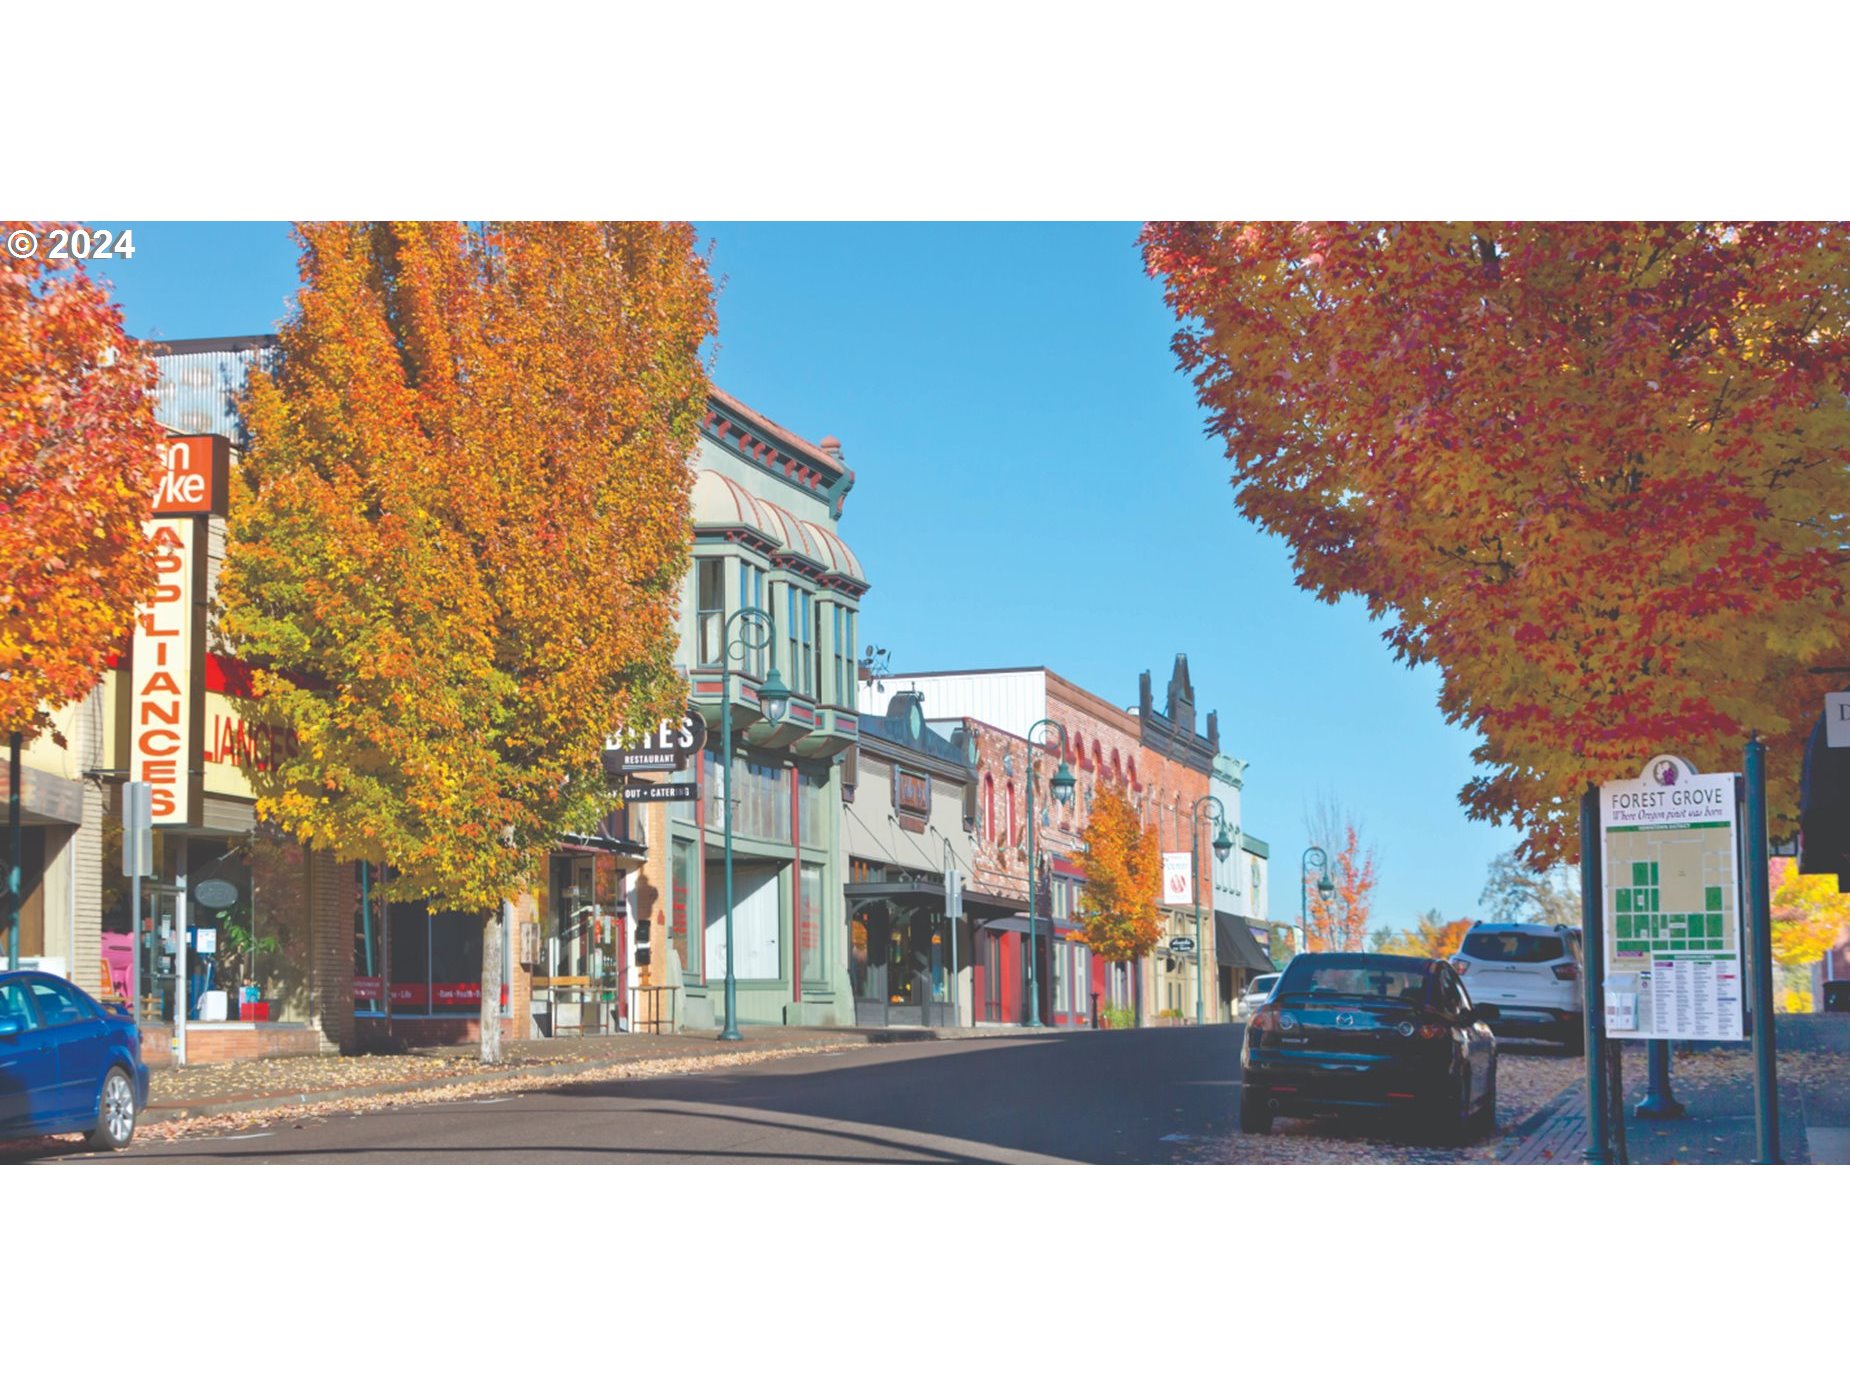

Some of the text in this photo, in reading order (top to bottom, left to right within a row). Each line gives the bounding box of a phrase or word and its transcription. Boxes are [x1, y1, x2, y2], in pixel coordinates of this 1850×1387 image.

[624, 754, 675, 764] RESTAURANT
[624, 788, 641, 799] OUT
[650, 787, 690, 798] CATERING
[1612, 788, 1723, 809] FOREST GROVE
[1612, 810, 1637, 821] Where
[1638, 808, 1666, 821] Oregon
[1665, 807, 1687, 820] pinot
[1703, 805, 1723, 817] born
